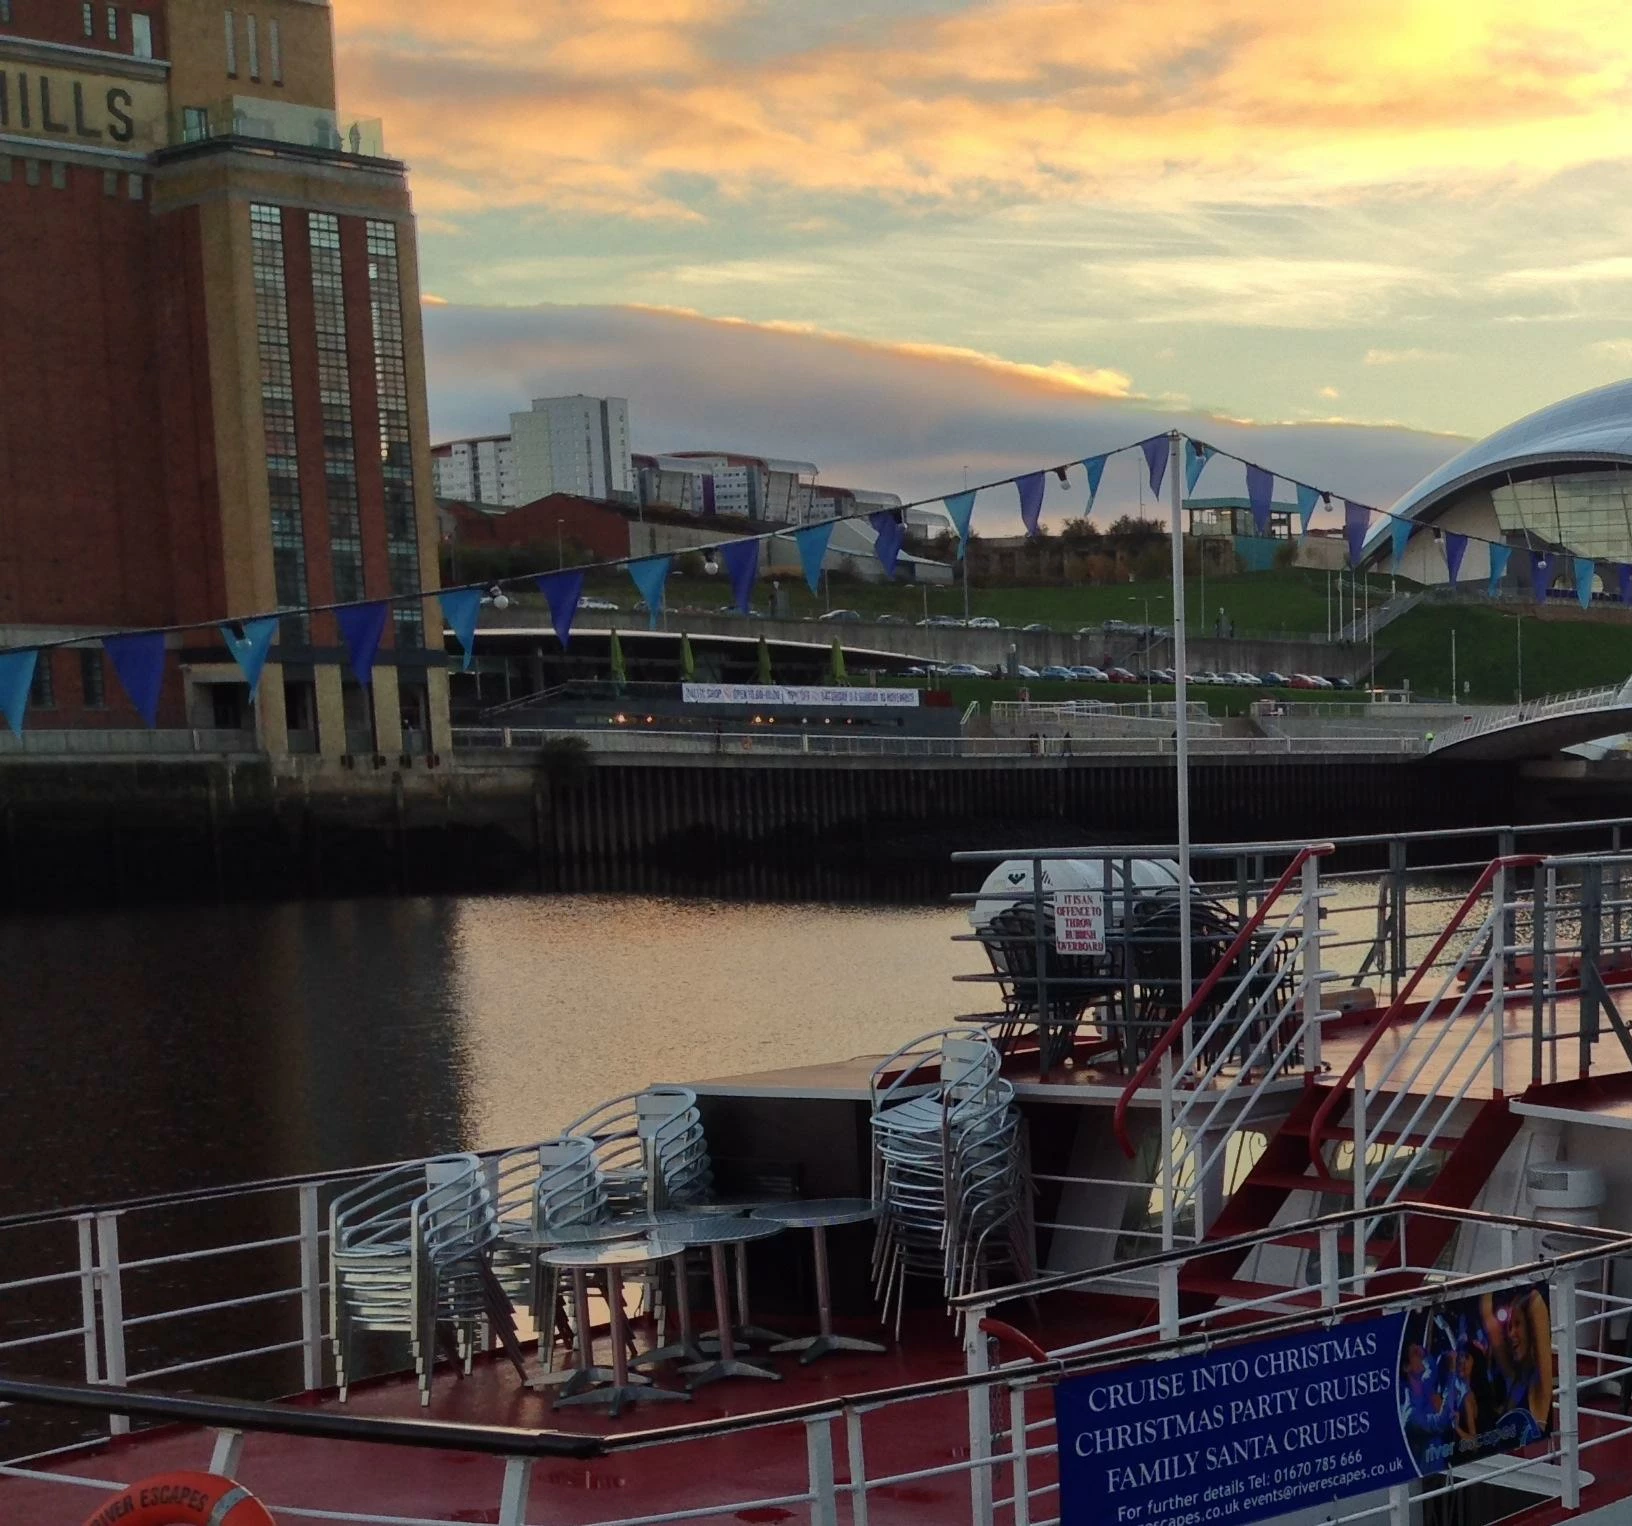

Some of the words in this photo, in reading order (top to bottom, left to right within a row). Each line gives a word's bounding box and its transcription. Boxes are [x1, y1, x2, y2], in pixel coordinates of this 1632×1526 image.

[0, 69, 134, 142] ILLS
[1056, 907, 1089, 916] OFFENCE
[1092, 907, 1102, 916] TO
[1064, 895, 1072, 904] IT
[1074, 895, 1080, 904] IS
[1082, 895, 1093, 904] AN
[1065, 918, 1092, 928] THROW
[1065, 930, 1096, 939] RUBBISH
[1058, 942, 1104, 951] OVERBOARD
[1087, 1372, 1185, 1413] CRUISE
[1192, 1361, 1249, 1391] INTO
[1254, 1332, 1378, 1378] CHRISTMAS
[1074, 1406, 1225, 1457] CHRISTMAS
[1230, 1387, 1300, 1425] PARTY
[1305, 1368, 1392, 1406] CRUISES
[1106, 1450, 1212, 1494] FAMILY
[1205, 1433, 1277, 1471] SANTA
[1283, 1411, 1371, 1452] CRUISES
[1425, 1441, 1456, 1464] river
[1117, 1504, 1143, 1523] For
[1147, 1492, 1199, 1516] further
[1203, 1480, 1246, 1503] details
[1247, 1473, 1271, 1491] Tel:
[1273, 1462, 1312, 1485] 01670
[1315, 1456, 1337, 1472] 785
[1339, 1449, 1363, 1466] 666
[1243, 1457, 1405, 1509] events@riverescapes.co.uk
[139, 1484, 210, 1513] ESCAPES
